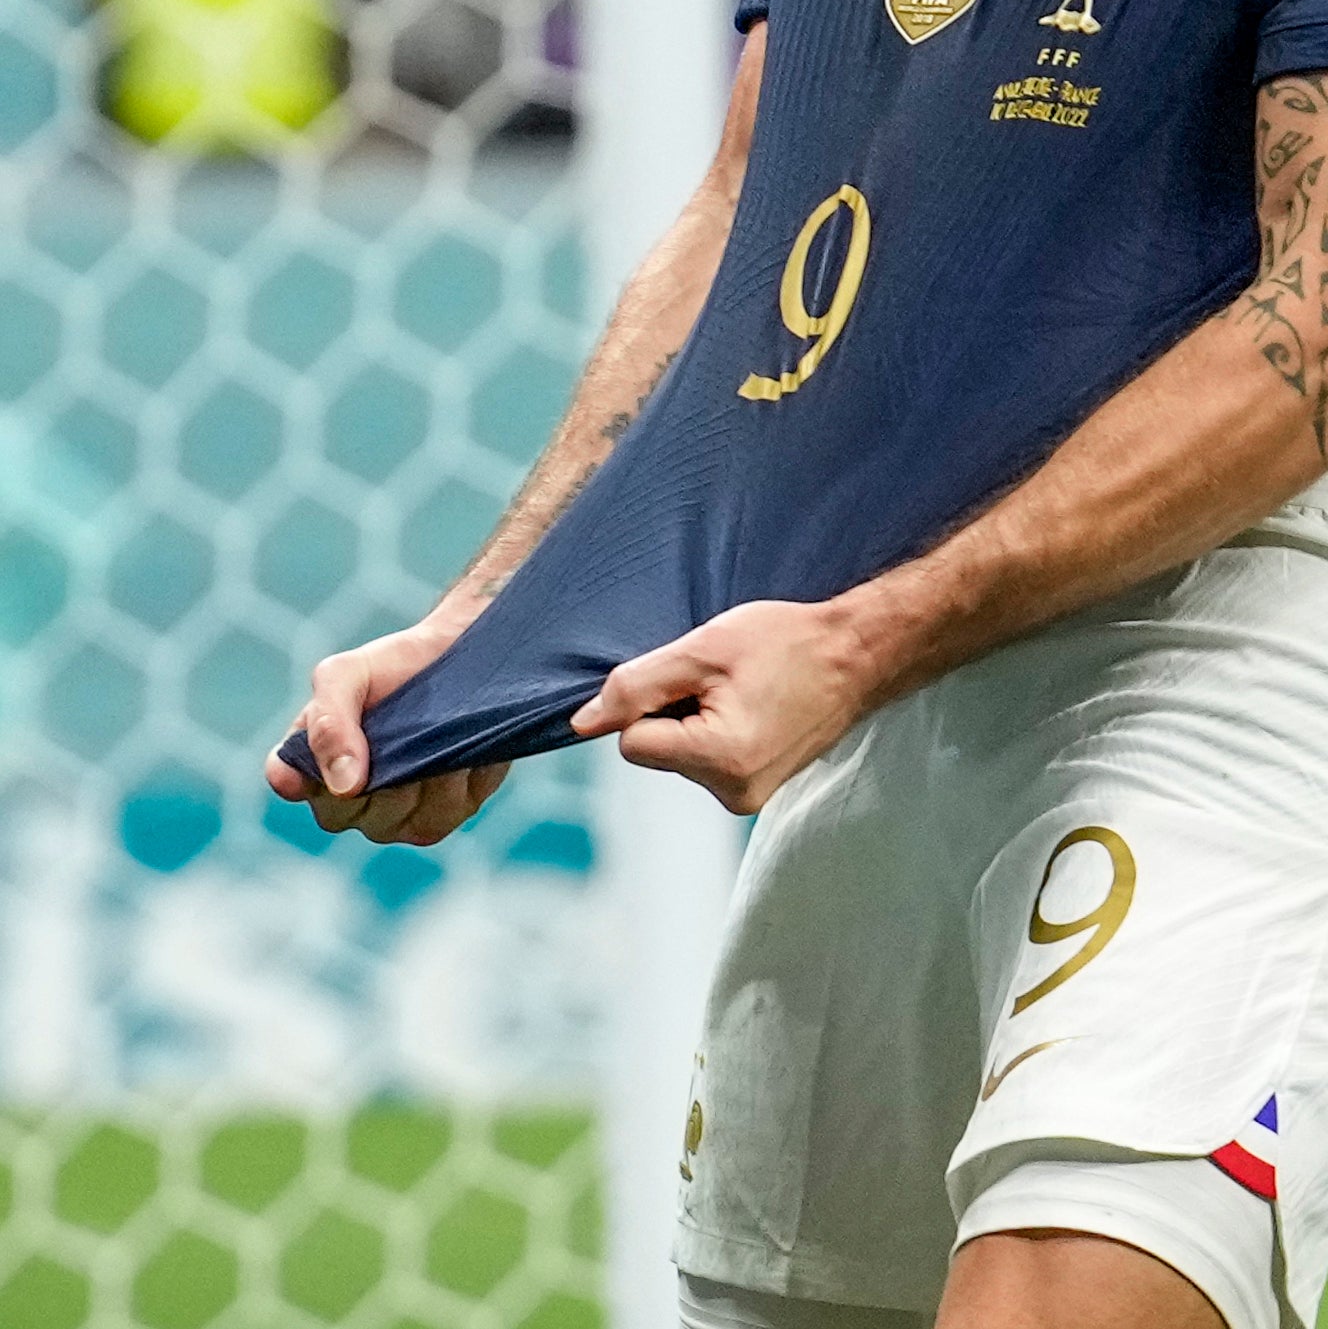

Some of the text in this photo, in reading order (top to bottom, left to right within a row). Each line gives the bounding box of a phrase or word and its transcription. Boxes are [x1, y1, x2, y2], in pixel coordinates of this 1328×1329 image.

[1036, 48, 1082, 68] FFF
[737, 184, 872, 402] 9
[1012, 825, 1138, 1017] 9
